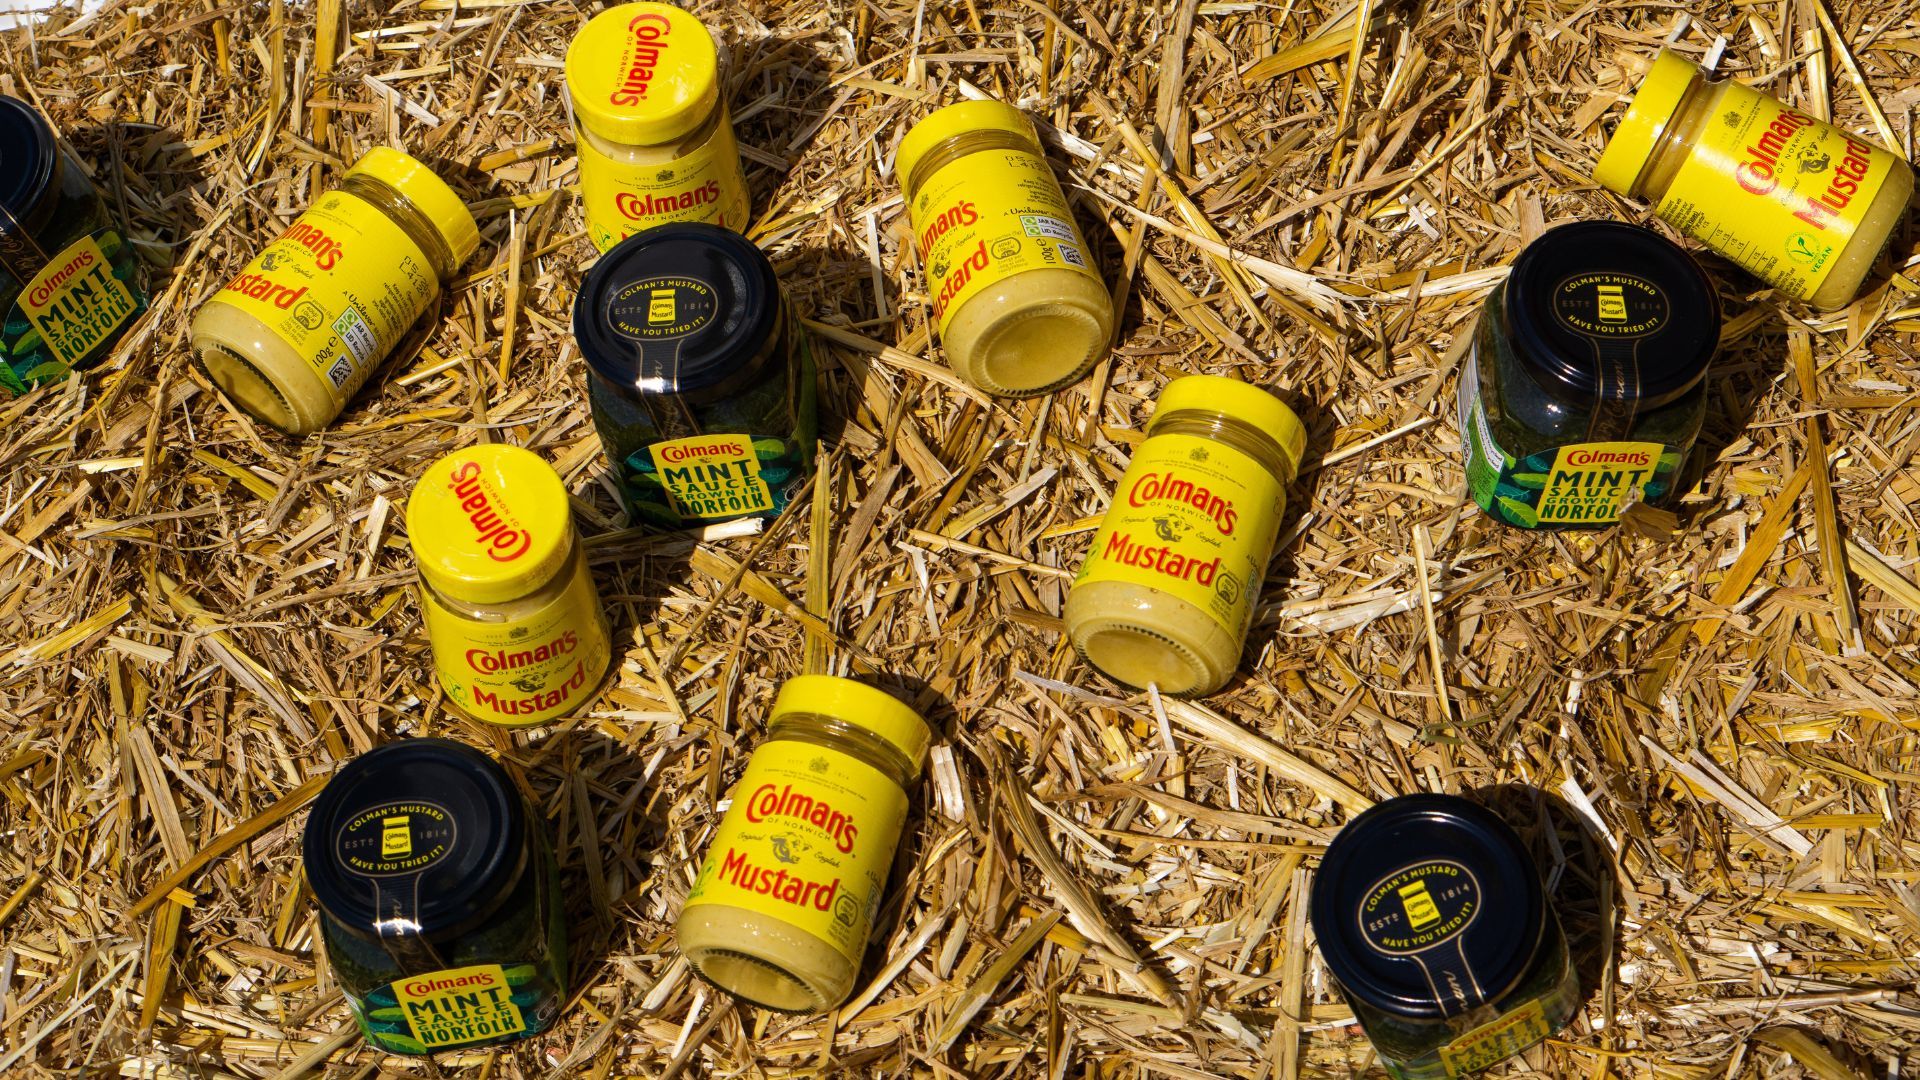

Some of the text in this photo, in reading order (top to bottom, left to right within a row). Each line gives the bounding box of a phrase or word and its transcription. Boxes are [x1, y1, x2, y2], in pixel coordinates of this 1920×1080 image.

[610, 13, 672, 107] Colman's
[616, 36, 633, 88] OF NORWICH
[1736, 109, 1815, 195] Colman's
[1777, 127, 1806, 174] OF NORWICH
[1793, 134, 1872, 230] Mustard
[616, 180, 720, 220] Colman's
[661, 204, 704, 220] NORWICH
[1810, 247, 1832, 273] VEGAN
[29, 250, 94, 308] Colman's
[226, 272, 309, 310] ustard
[620, 280, 707, 301] COLMAN'S MUSTARD
[1564, 276, 1656, 296] COLMAN'S MUSTARD
[37, 262, 110, 333] MINT
[49, 279, 115, 341] SAUCE
[684, 302, 710, 310] 1814
[55, 288, 120, 350] GROWN IN
[60, 299, 131, 364] NORFOLK
[618, 316, 705, 336] HAVE YOU TRIED IT?
[1568, 315, 1659, 333] HAVE YOU TRIED IT?
[312, 348, 333, 368] 100g
[661, 442, 744, 463] Colman's
[1566, 450, 1650, 466] Colman's
[664, 459, 752, 484] MINT
[1552, 470, 1648, 488] MINT
[670, 476, 758, 494] SAUCE
[674, 486, 760, 500] GROWN IN
[1549, 487, 1638, 498] SAUC
[448, 462, 532, 562] Colman's
[481, 478, 520, 527] OF NORWICH
[676, 492, 766, 516] NORFOLK
[1129, 472, 1238, 536] Colman's
[1166, 504, 1212, 523] NORWICH
[1540, 504, 1618, 520] NORFOL
[1104, 531, 1222, 588] Mustard
[466, 630, 577, 675] Colman's
[515, 656, 560, 675] NORWICH
[472, 658, 586, 716] Mustard
[349, 806, 444, 832] COLMAN'S MUSTARD
[746, 784, 858, 854] Colman's
[784, 821, 832, 841] NORWICH
[385, 841, 408, 850] Mustard
[420, 830, 448, 840] 1814
[350, 844, 445, 871] HAVE YOU TRIED IT?
[814, 850, 840, 868] English
[718, 848, 840, 912] Mustard
[1366, 866, 1458, 912] COLMAN'S MUSTARD
[1441, 883, 1470, 901] 1814
[1382, 902, 1473, 948] HAVE YOU TRIED IT?
[1411, 907, 1435, 920] Mustard
[405, 972, 494, 996] Colman's
[406, 986, 502, 1017] MINT
[414, 1000, 508, 1025] SAUCE
[418, 1009, 511, 1031] GROWN IN
[420, 1018, 518, 1044] NORFOLK
